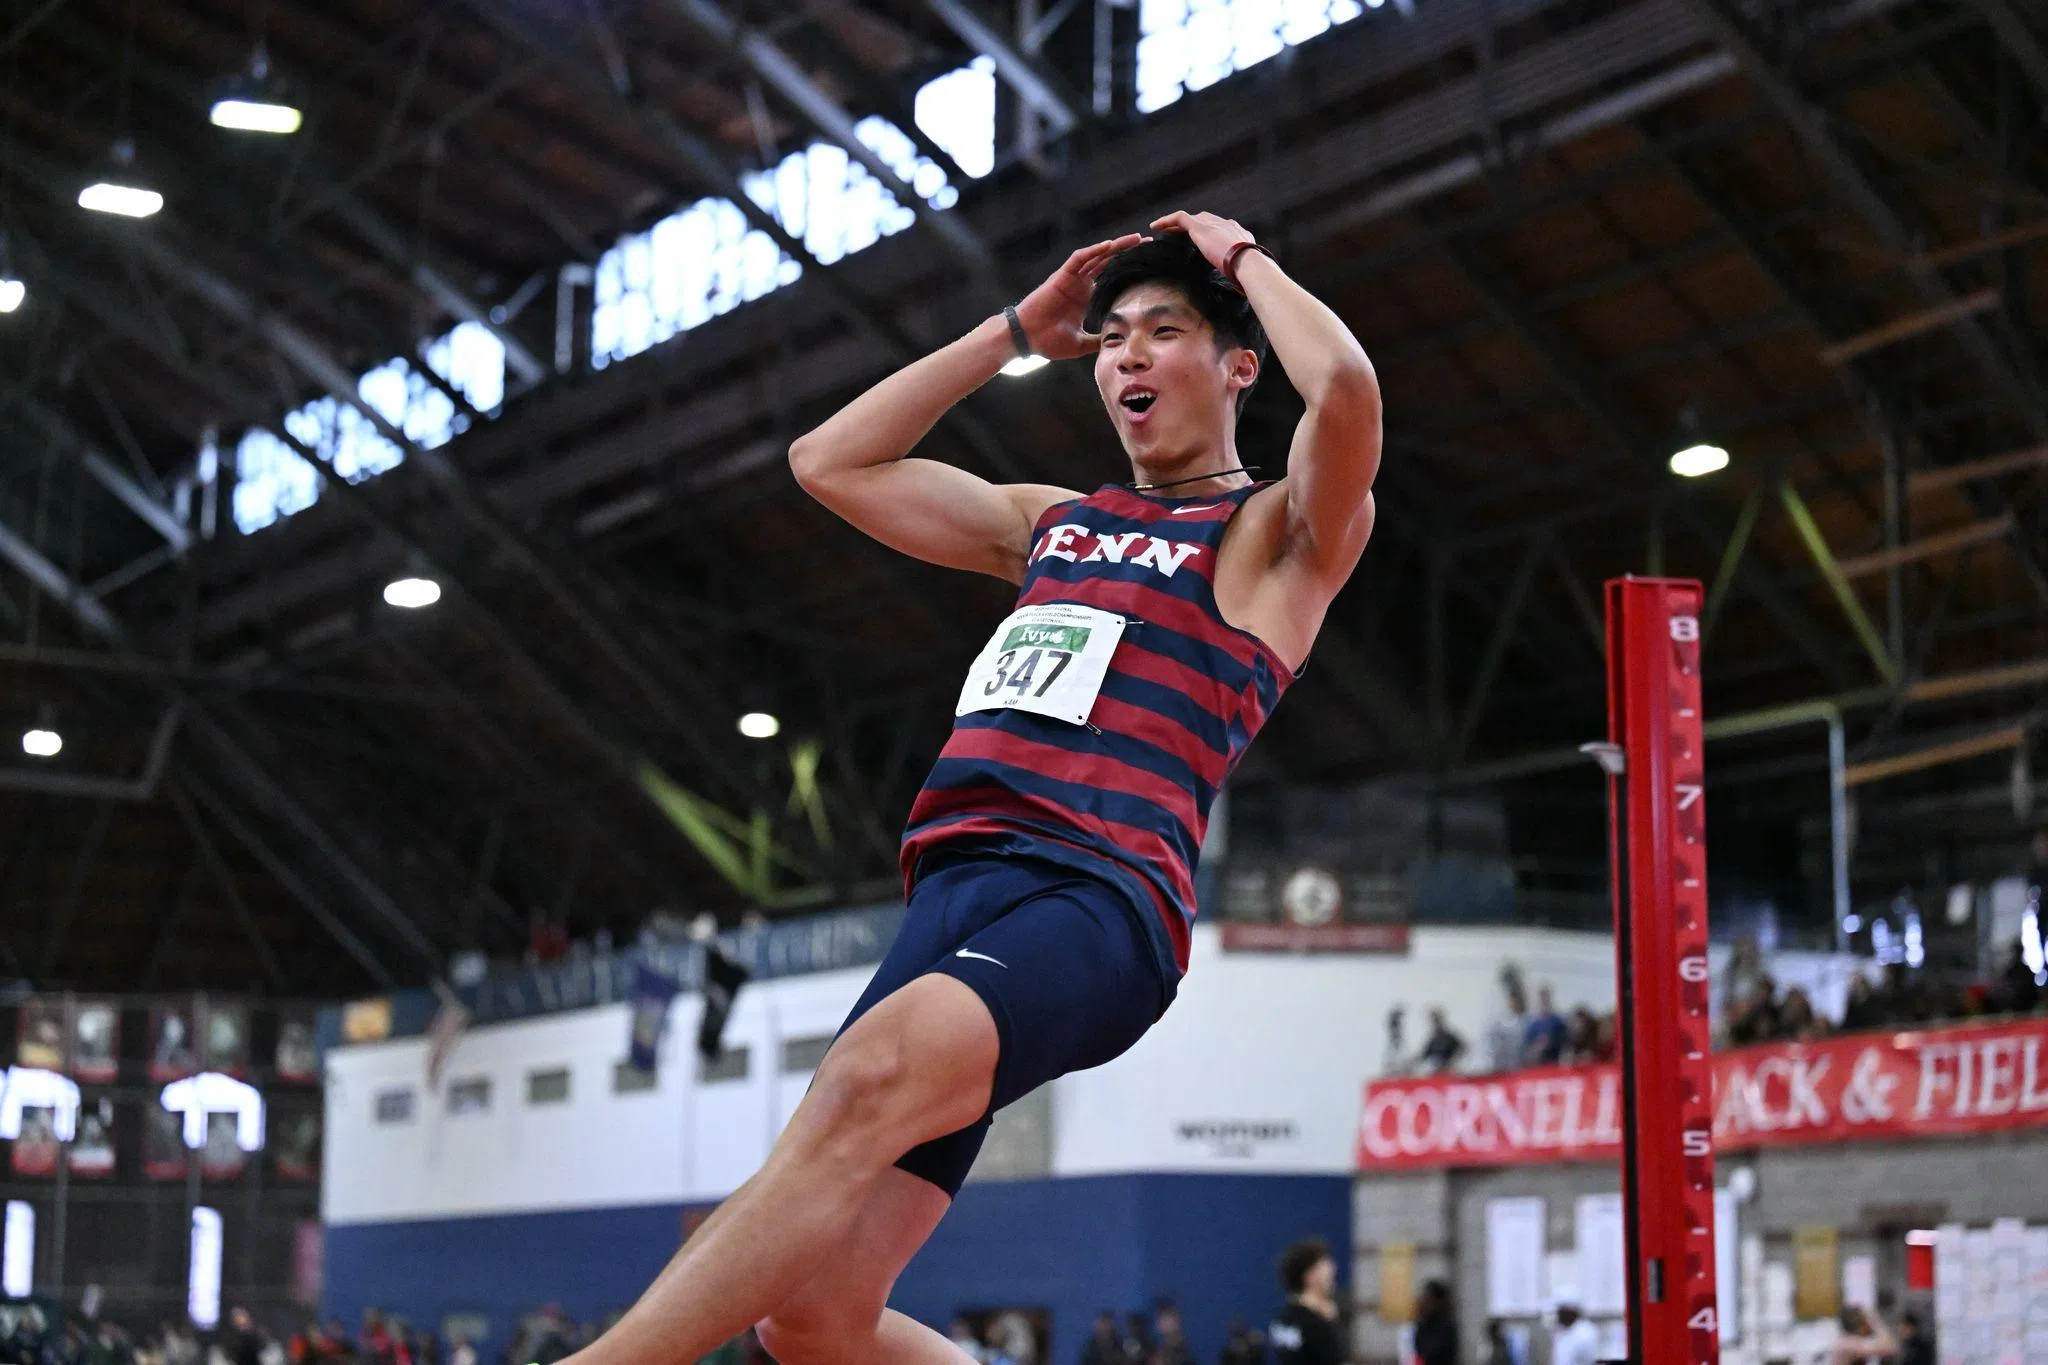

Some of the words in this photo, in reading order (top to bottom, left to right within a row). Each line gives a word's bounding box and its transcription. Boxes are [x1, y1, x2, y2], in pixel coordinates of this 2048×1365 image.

[1027, 524, 1201, 578] ENN
[1019, 626, 1051, 645] Ivy
[1669, 615, 1699, 642] 8
[984, 648, 1073, 698] 347
[1674, 784, 1703, 811] 7
[1679, 956, 1708, 982] 6
[1362, 1074, 1622, 1158] CORNELL
[1712, 1052, 1832, 1138] ACK
[1841, 1047, 1897, 1124] &
[1913, 1034, 2048, 1121] FIEL
[1682, 1129, 1711, 1157] 5
[1687, 1306, 1716, 1332] 4
